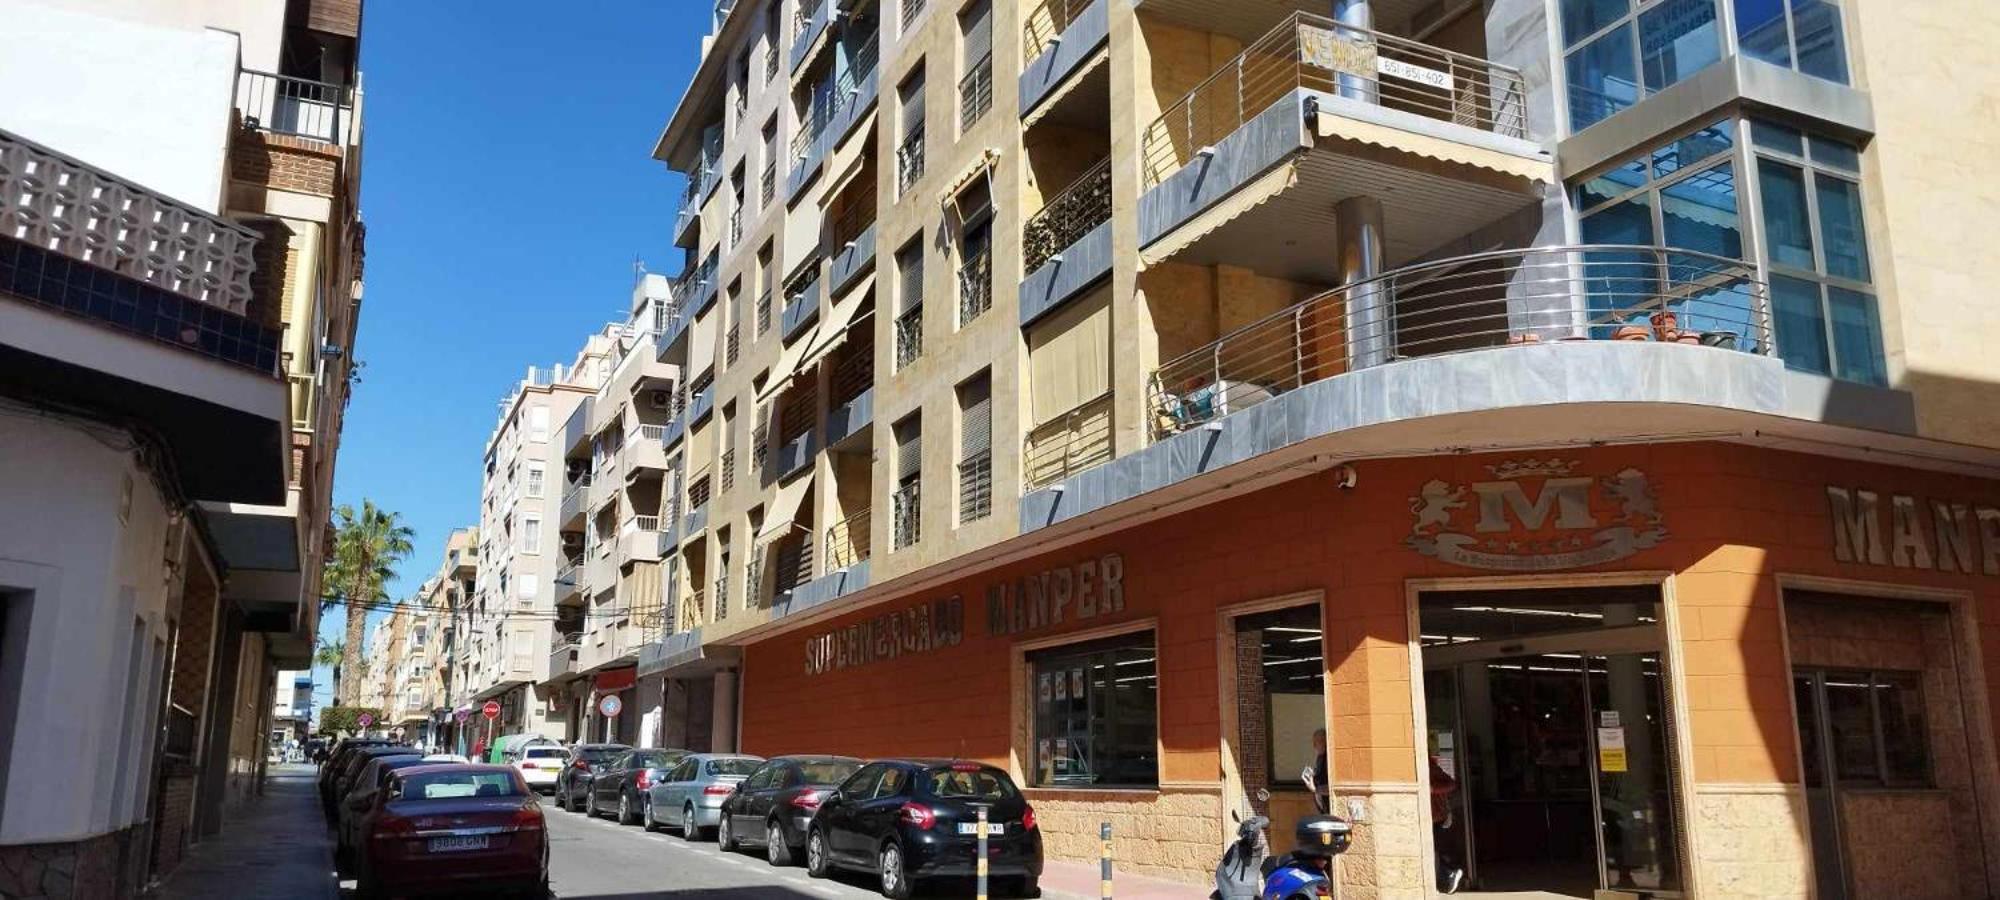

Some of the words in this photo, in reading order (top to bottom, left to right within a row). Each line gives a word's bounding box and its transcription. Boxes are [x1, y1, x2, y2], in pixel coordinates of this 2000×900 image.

[1472, 477, 1597, 532] M
[805, 595, 964, 675] SUPERMERCADO
[986, 553, 1125, 637] MANPER
